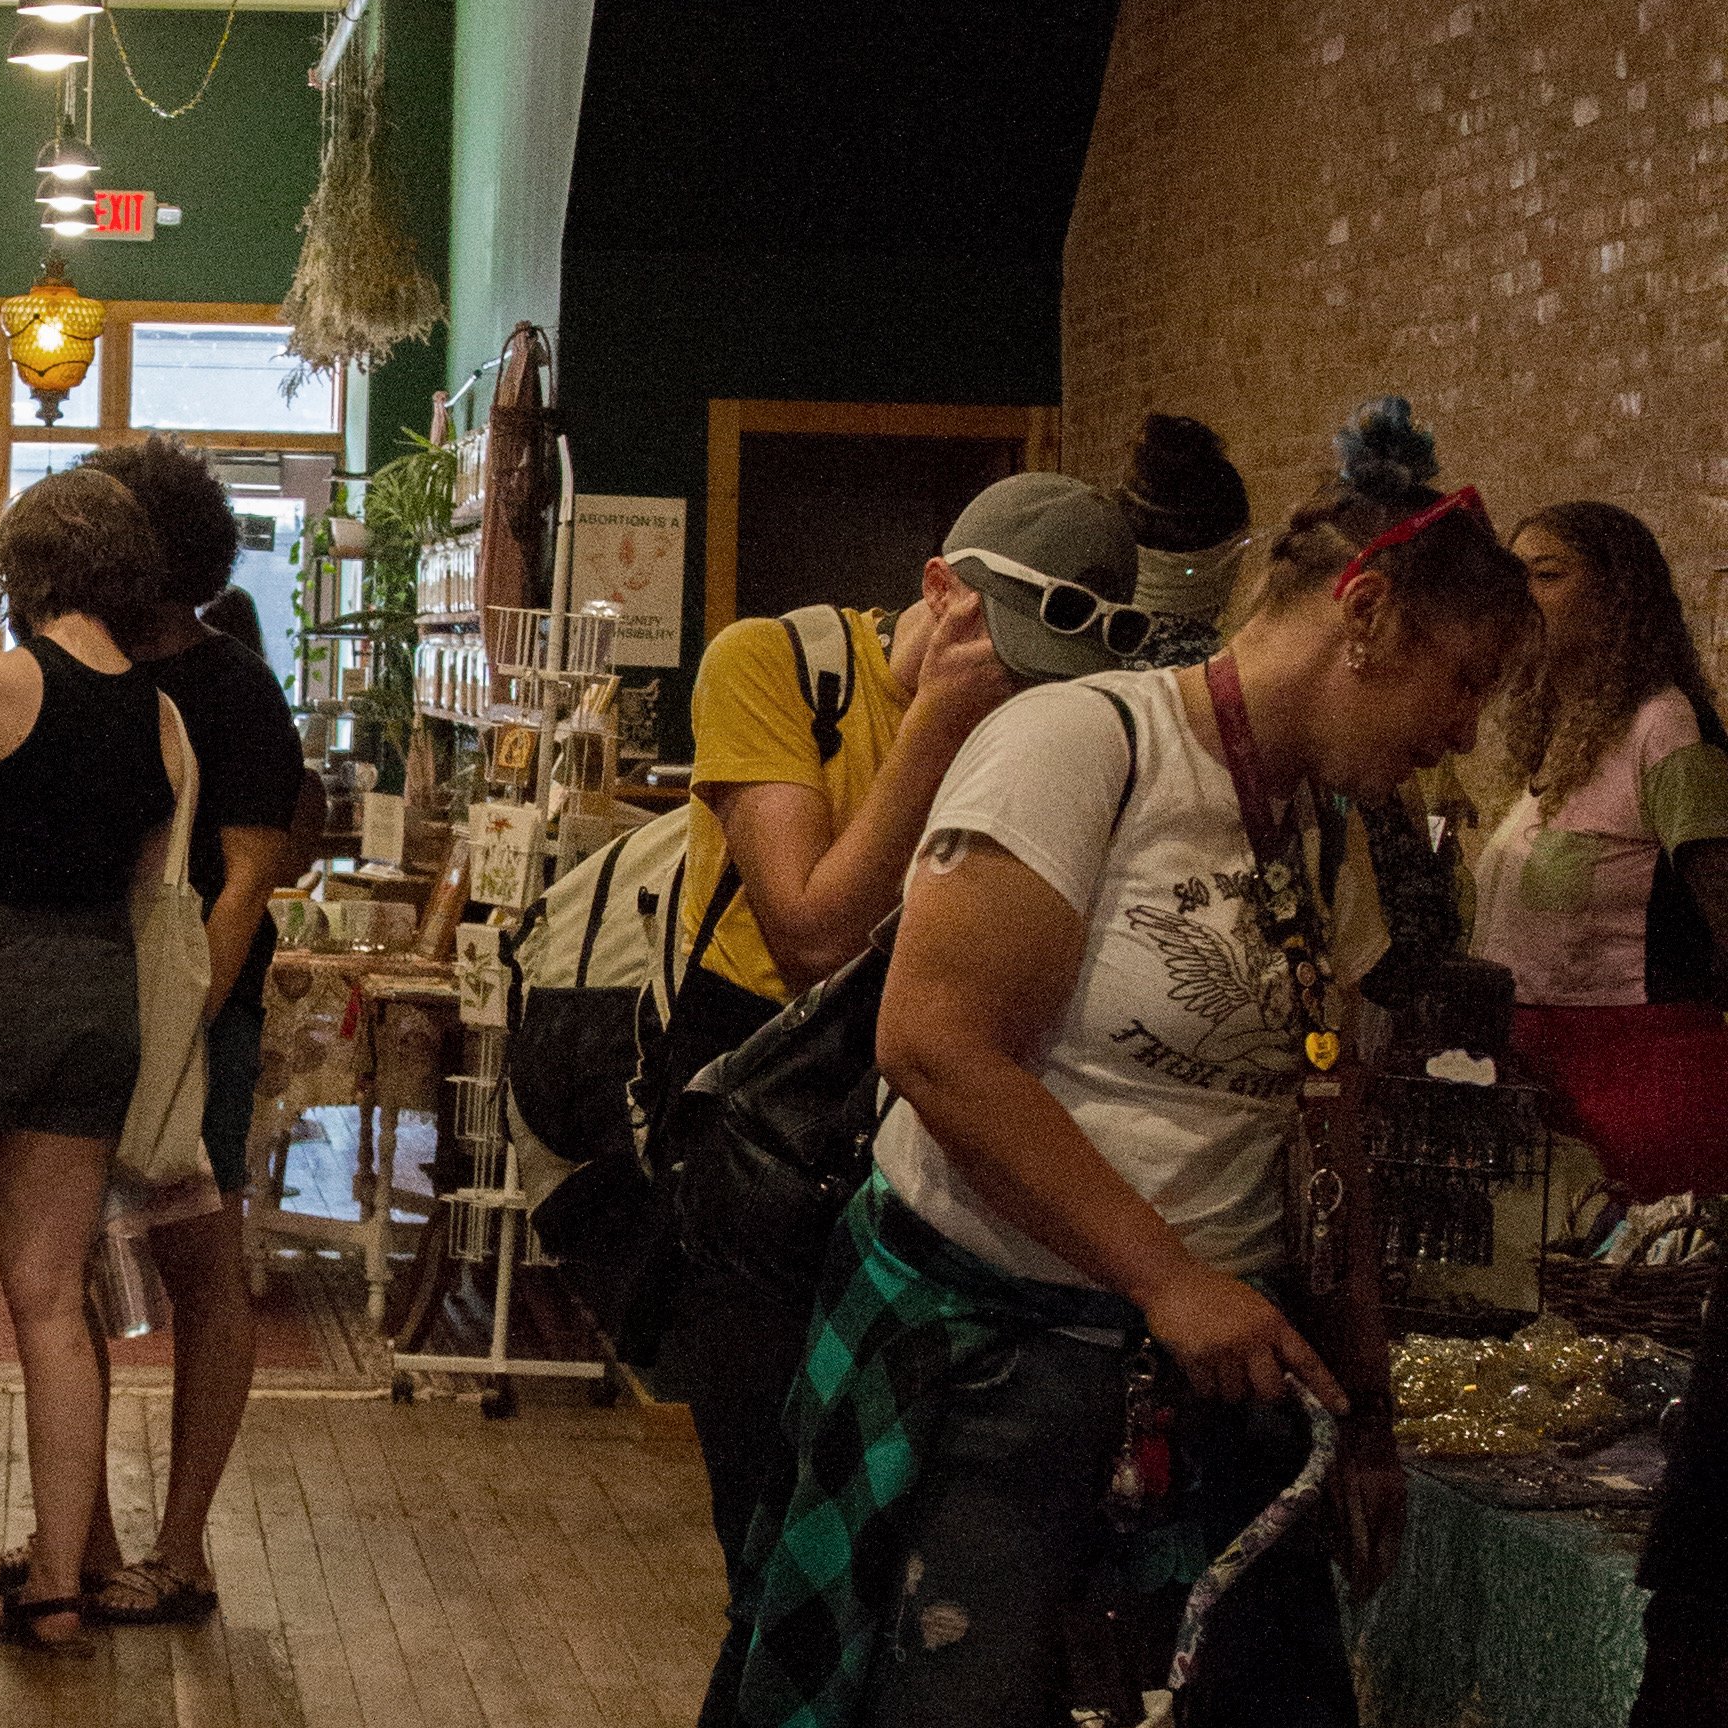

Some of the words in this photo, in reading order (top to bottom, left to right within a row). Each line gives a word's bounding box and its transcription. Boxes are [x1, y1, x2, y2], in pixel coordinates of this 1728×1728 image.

[94, 194, 145, 231] EXIT
[578, 513, 650, 527] ABORTION
[653, 516, 666, 527] IS
[671, 517, 680, 528] A
